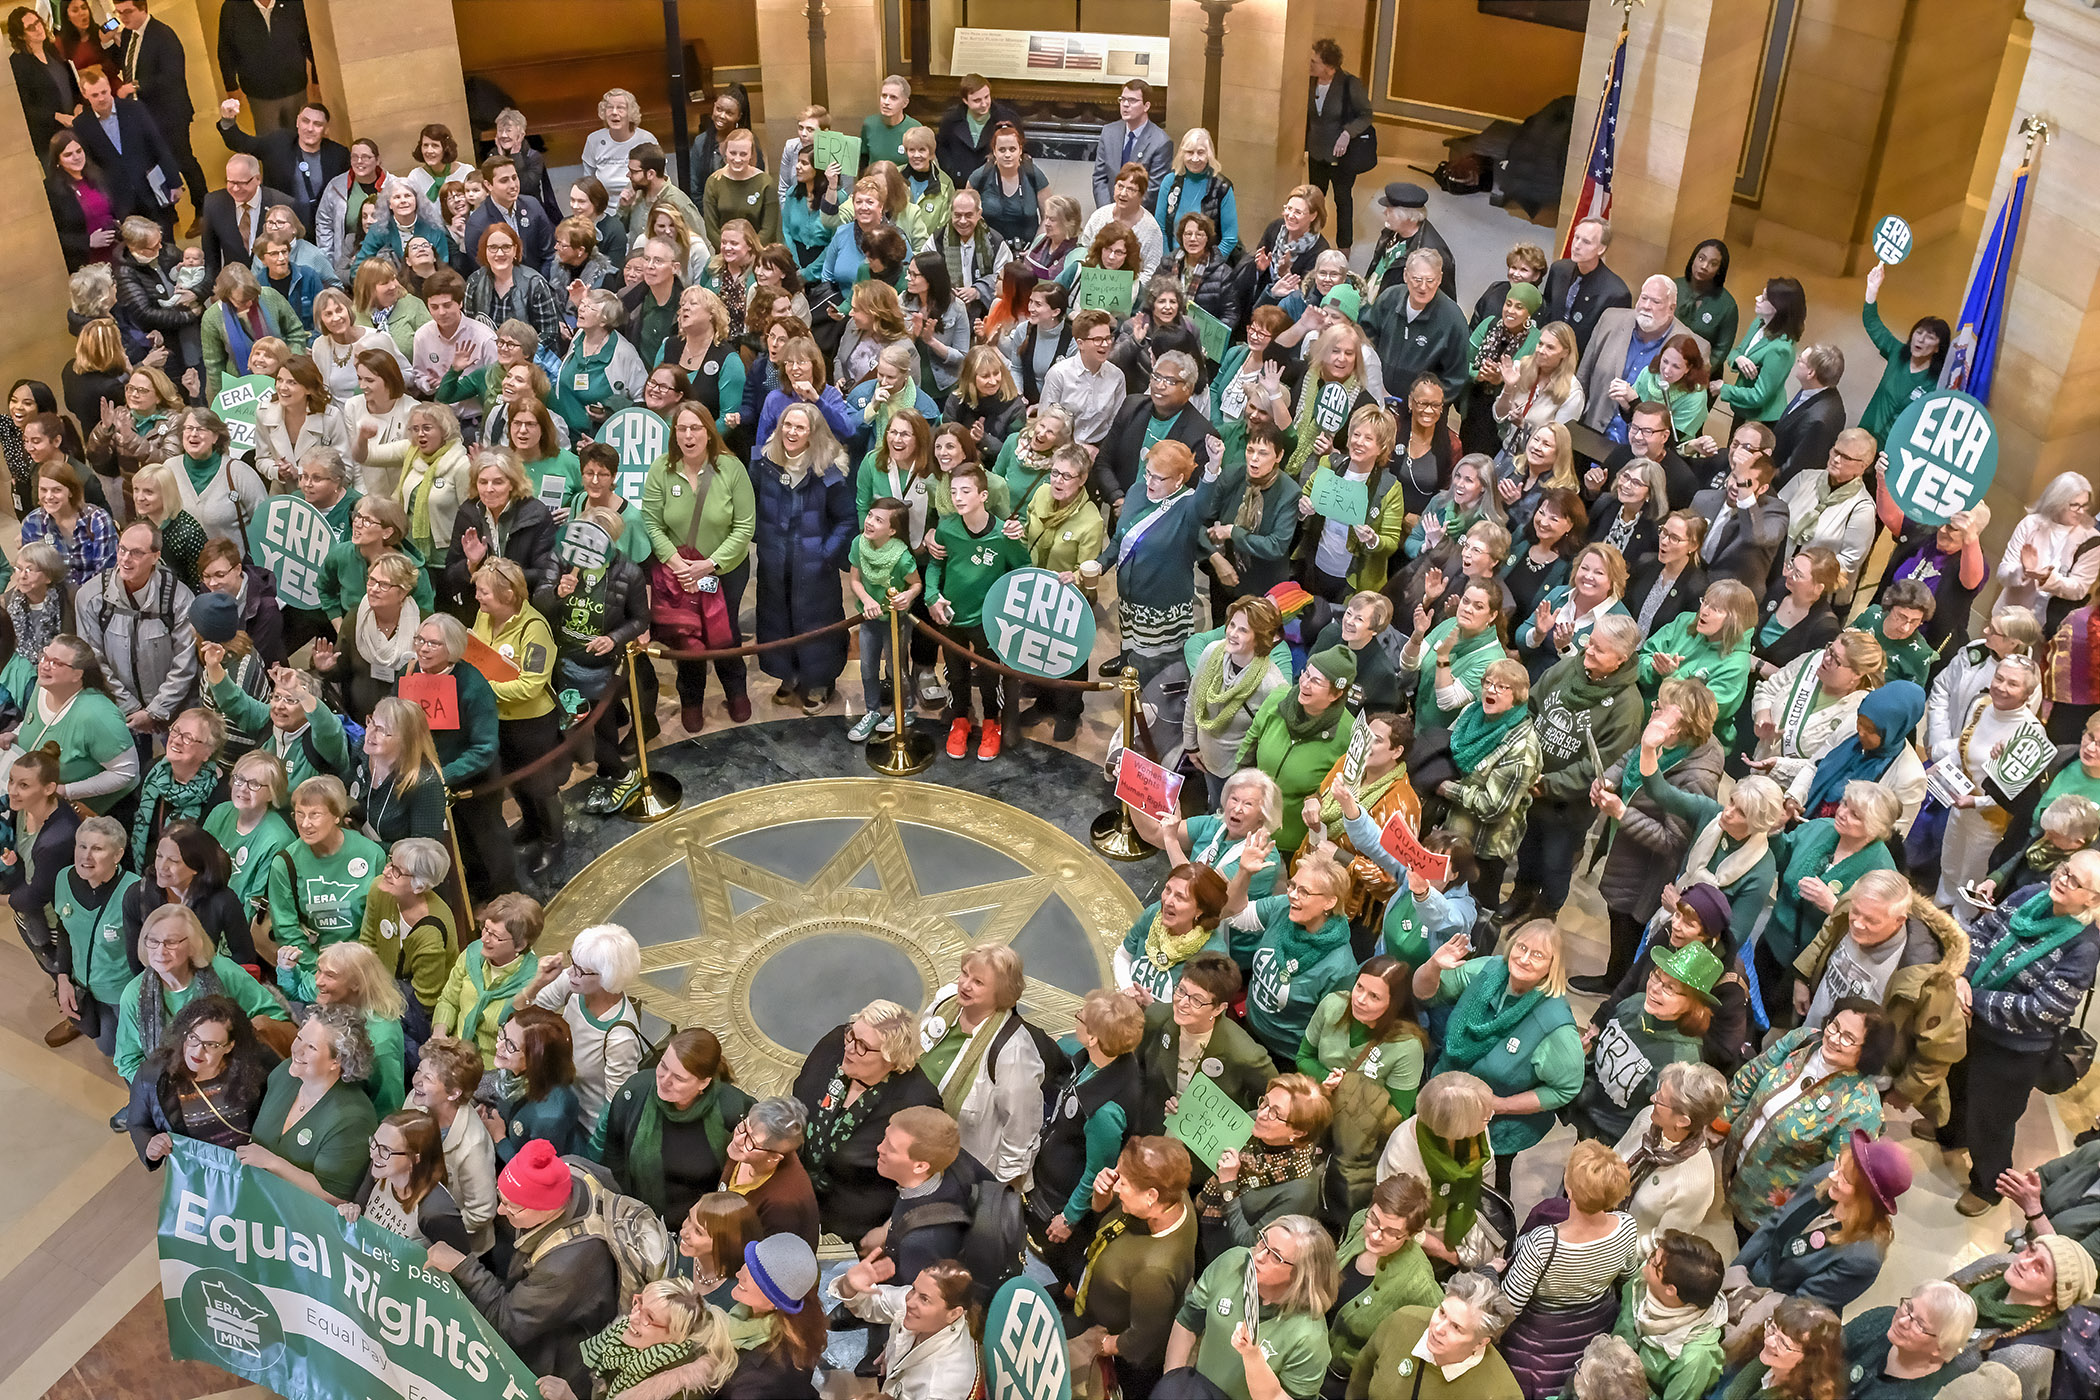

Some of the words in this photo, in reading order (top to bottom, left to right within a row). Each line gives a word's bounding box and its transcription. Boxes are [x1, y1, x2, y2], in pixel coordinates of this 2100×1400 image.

[817, 135, 853, 169] ERA
[1873, 232, 1904, 265] YES
[1880, 216, 1911, 251] ERA
[1085, 293, 1120, 307] ERA
[221, 387, 253, 407] ERA
[1320, 383, 1348, 414] ERA
[1315, 405, 1343, 433] YES
[605, 412, 664, 465] ERA
[1909, 396, 1992, 475] ERA
[1895, 447, 1975, 518] YES
[1319, 490, 1358, 517] ERA
[265, 500, 331, 568] ERA
[560, 540, 607, 570] YES
[259, 542, 321, 606] YES
[1003, 572, 1084, 639] ERA
[994, 616, 1078, 676] YES
[420, 698, 447, 719] RA
[1556, 748, 1572, 760] MN
[2001, 752, 2031, 781] YES
[2012, 738, 2041, 770] ERA
[1120, 780, 1145, 799] Human
[1389, 820, 1443, 867] EQUALITY
[1395, 844, 1426, 869] NOW
[313, 893, 337, 904] ERA
[319, 917, 338, 926] MN
[1179, 1112, 1219, 1157] ERA
[1199, 1111, 1216, 1130] for
[374, 1195, 408, 1231] BADASS
[361, 1237, 400, 1272] Let's
[408, 1263, 451, 1294] pass
[174, 1189, 332, 1280] Equal
[342, 1251, 492, 1383] Rights
[213, 1300, 243, 1319] ERA
[220, 1331, 244, 1349] MN
[306, 1307, 355, 1347] Equal
[362, 1338, 389, 1371] Pay
[1000, 1288, 1067, 1400] ERA
